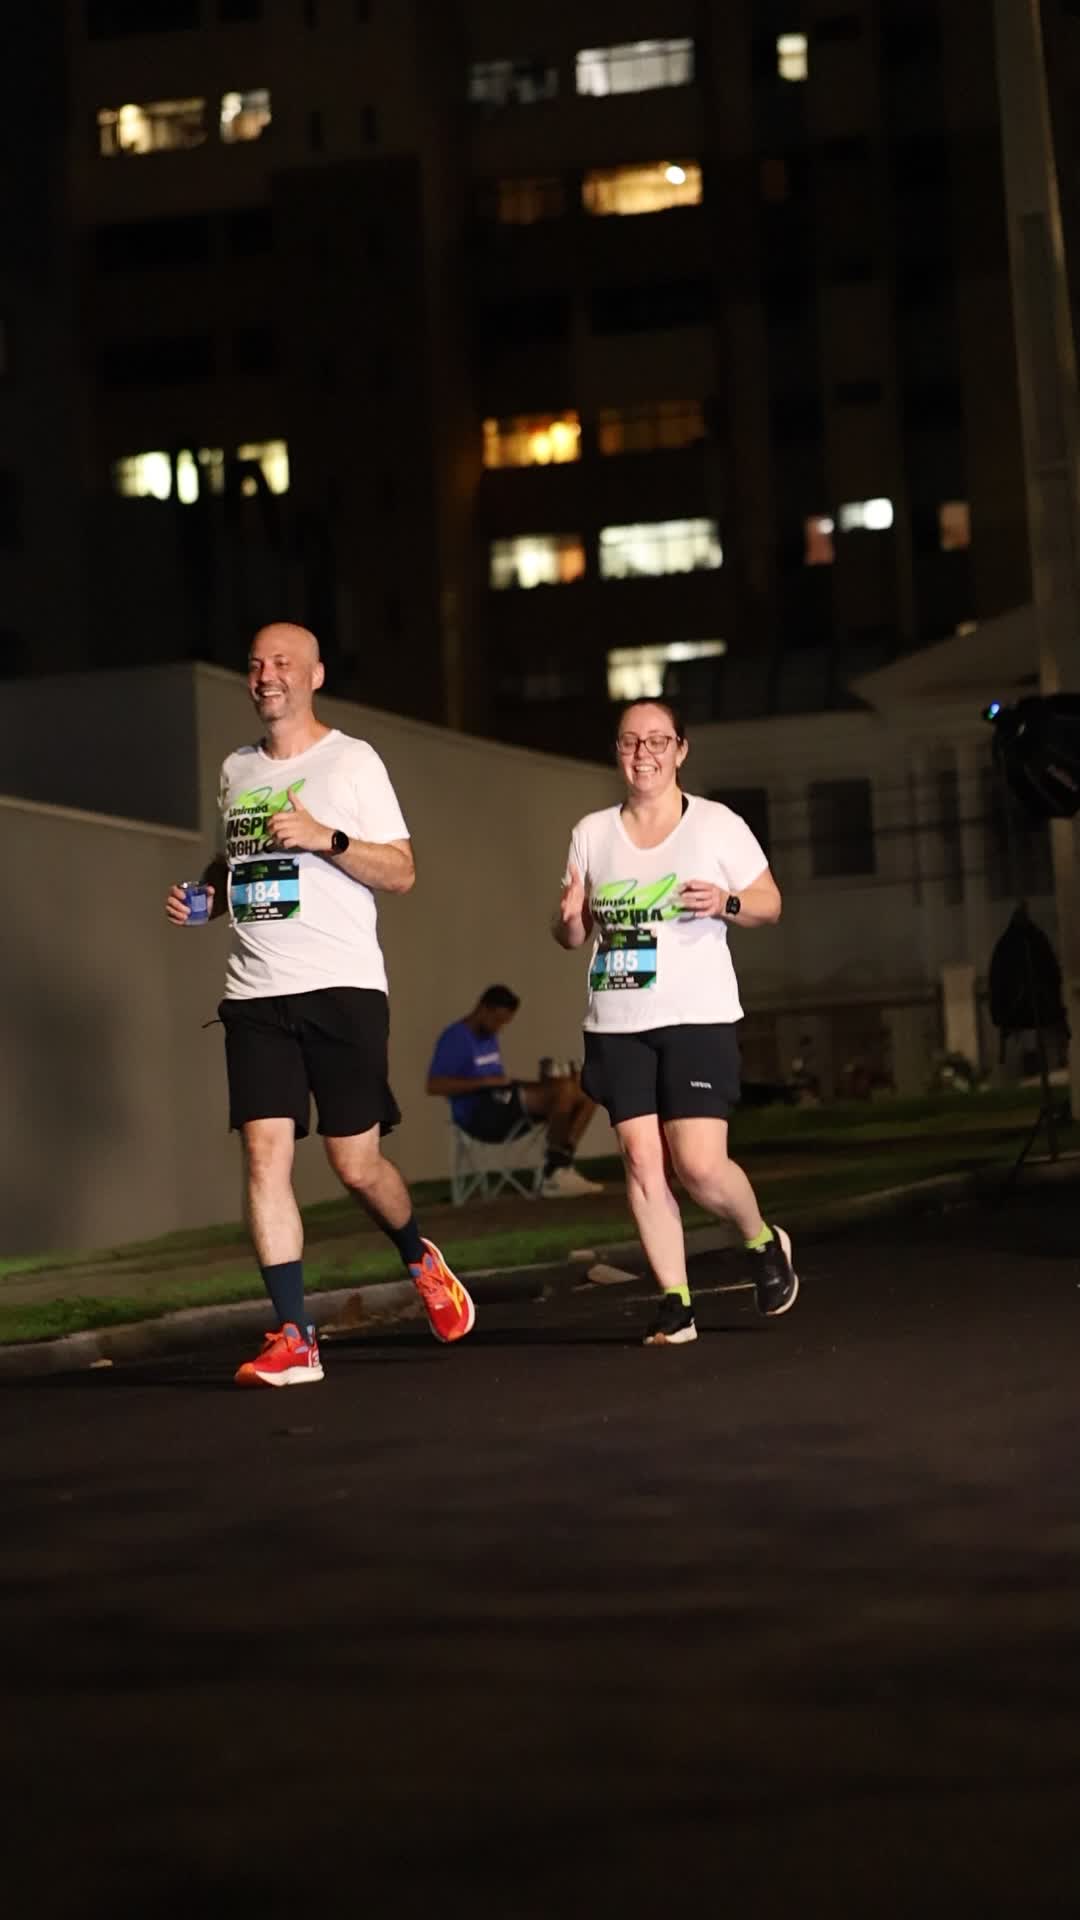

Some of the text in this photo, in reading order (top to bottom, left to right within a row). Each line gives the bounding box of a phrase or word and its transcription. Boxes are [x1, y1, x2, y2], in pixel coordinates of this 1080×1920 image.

[226, 816, 268, 839] INSPI
[245, 880, 280, 903] 184
[604, 949, 638, 972] 185
